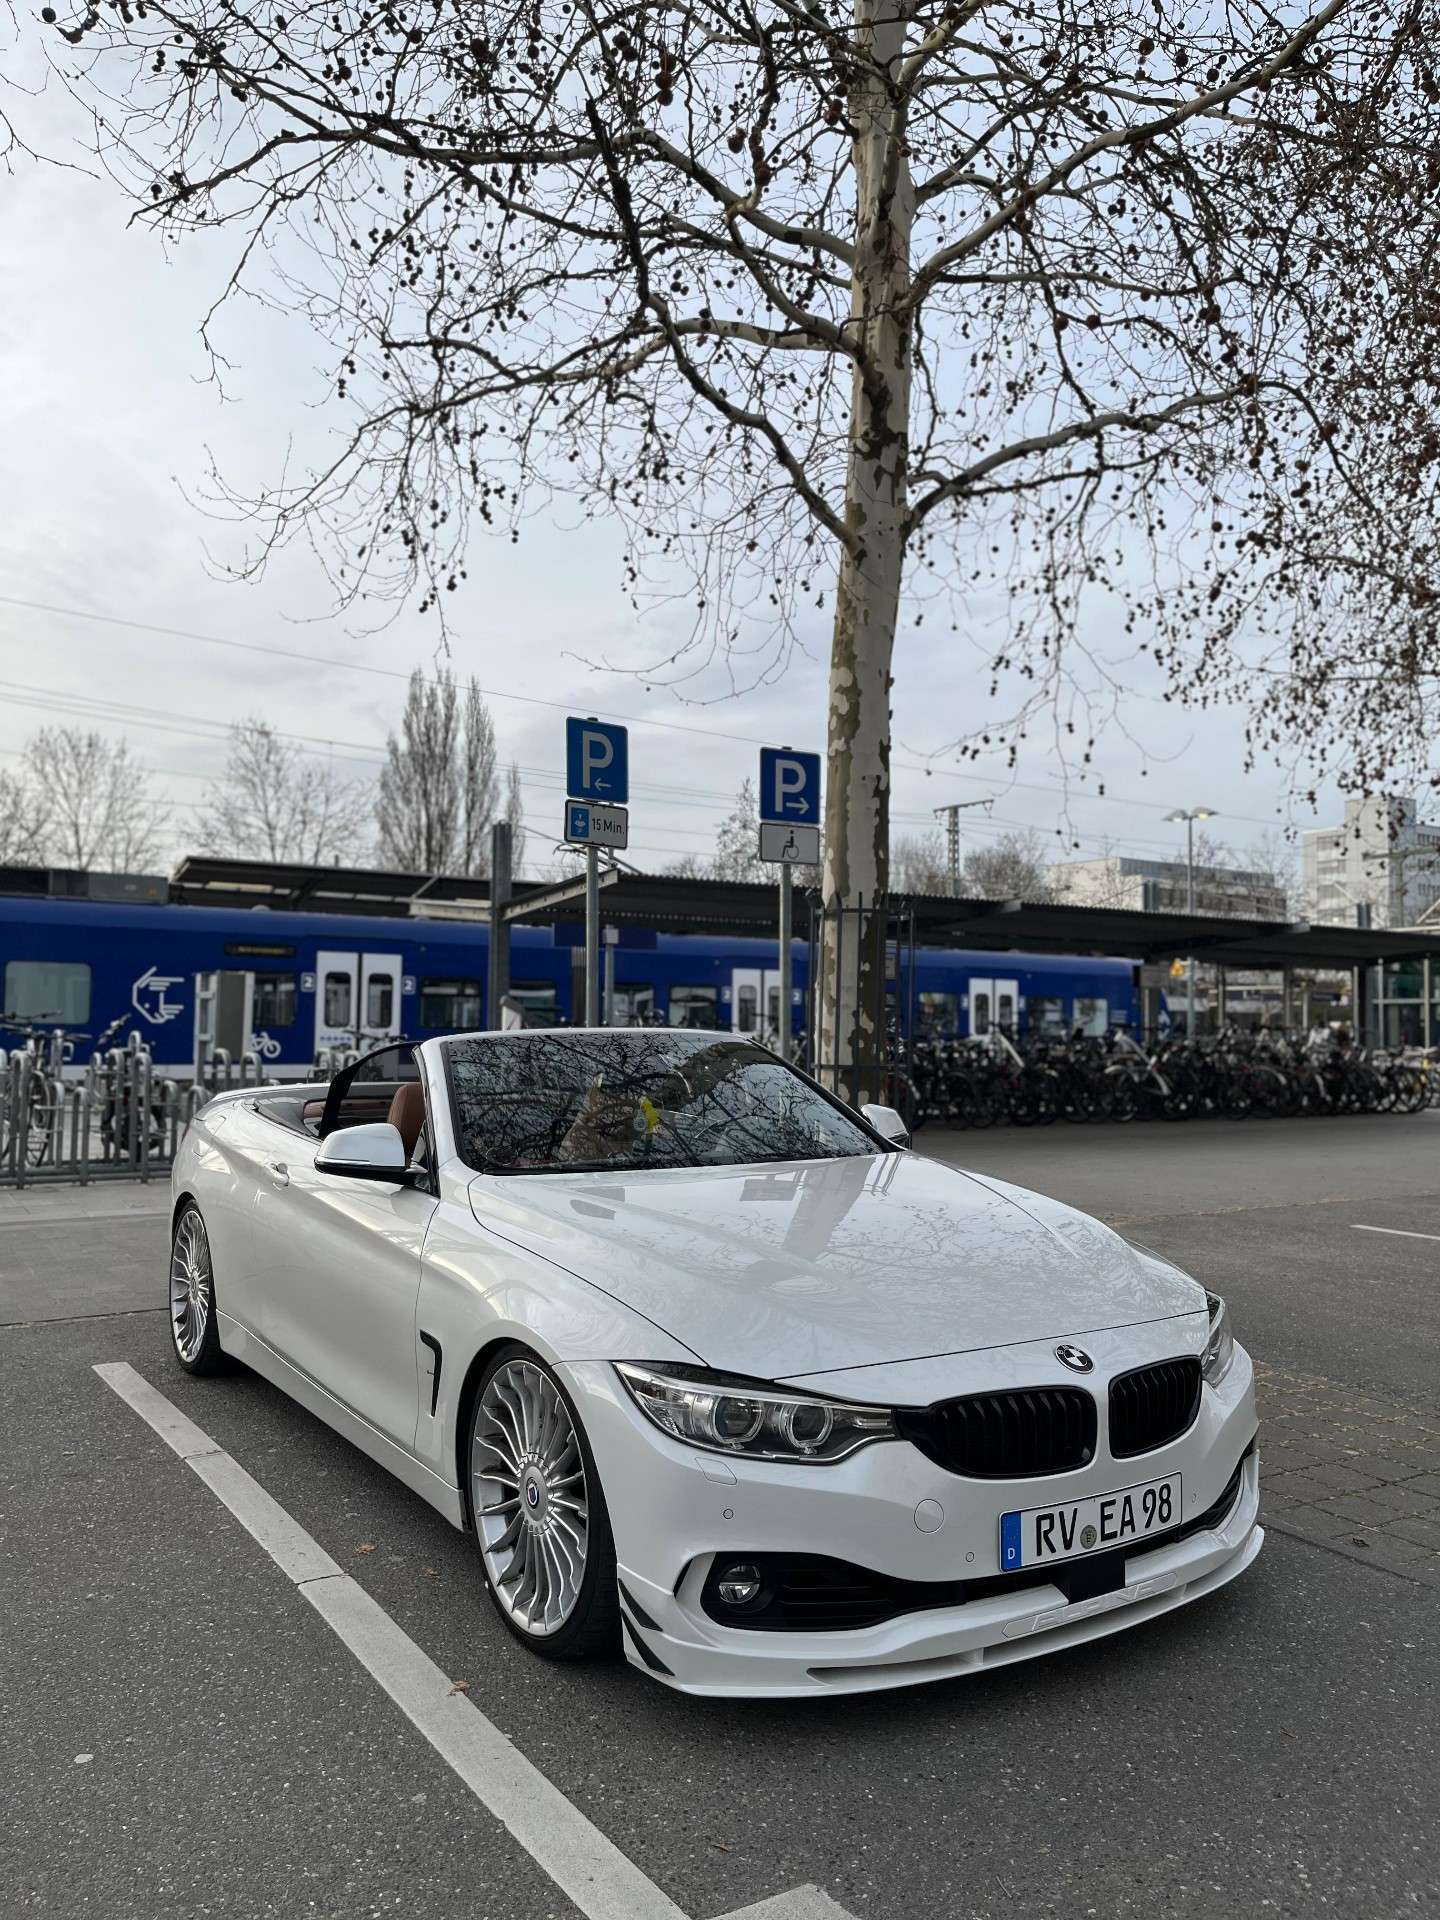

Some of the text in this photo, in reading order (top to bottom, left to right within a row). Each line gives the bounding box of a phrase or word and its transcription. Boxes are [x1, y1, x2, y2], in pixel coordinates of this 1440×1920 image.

[582, 730, 614, 789] P
[775, 758, 807, 813] P
[592, 817, 625, 835] 15 Min.
[1036, 1508, 1078, 1556] RV
[1101, 1494, 1136, 1542] EA
[1142, 1483, 1172, 1529] 98
[1007, 1547, 1016, 1560] D
